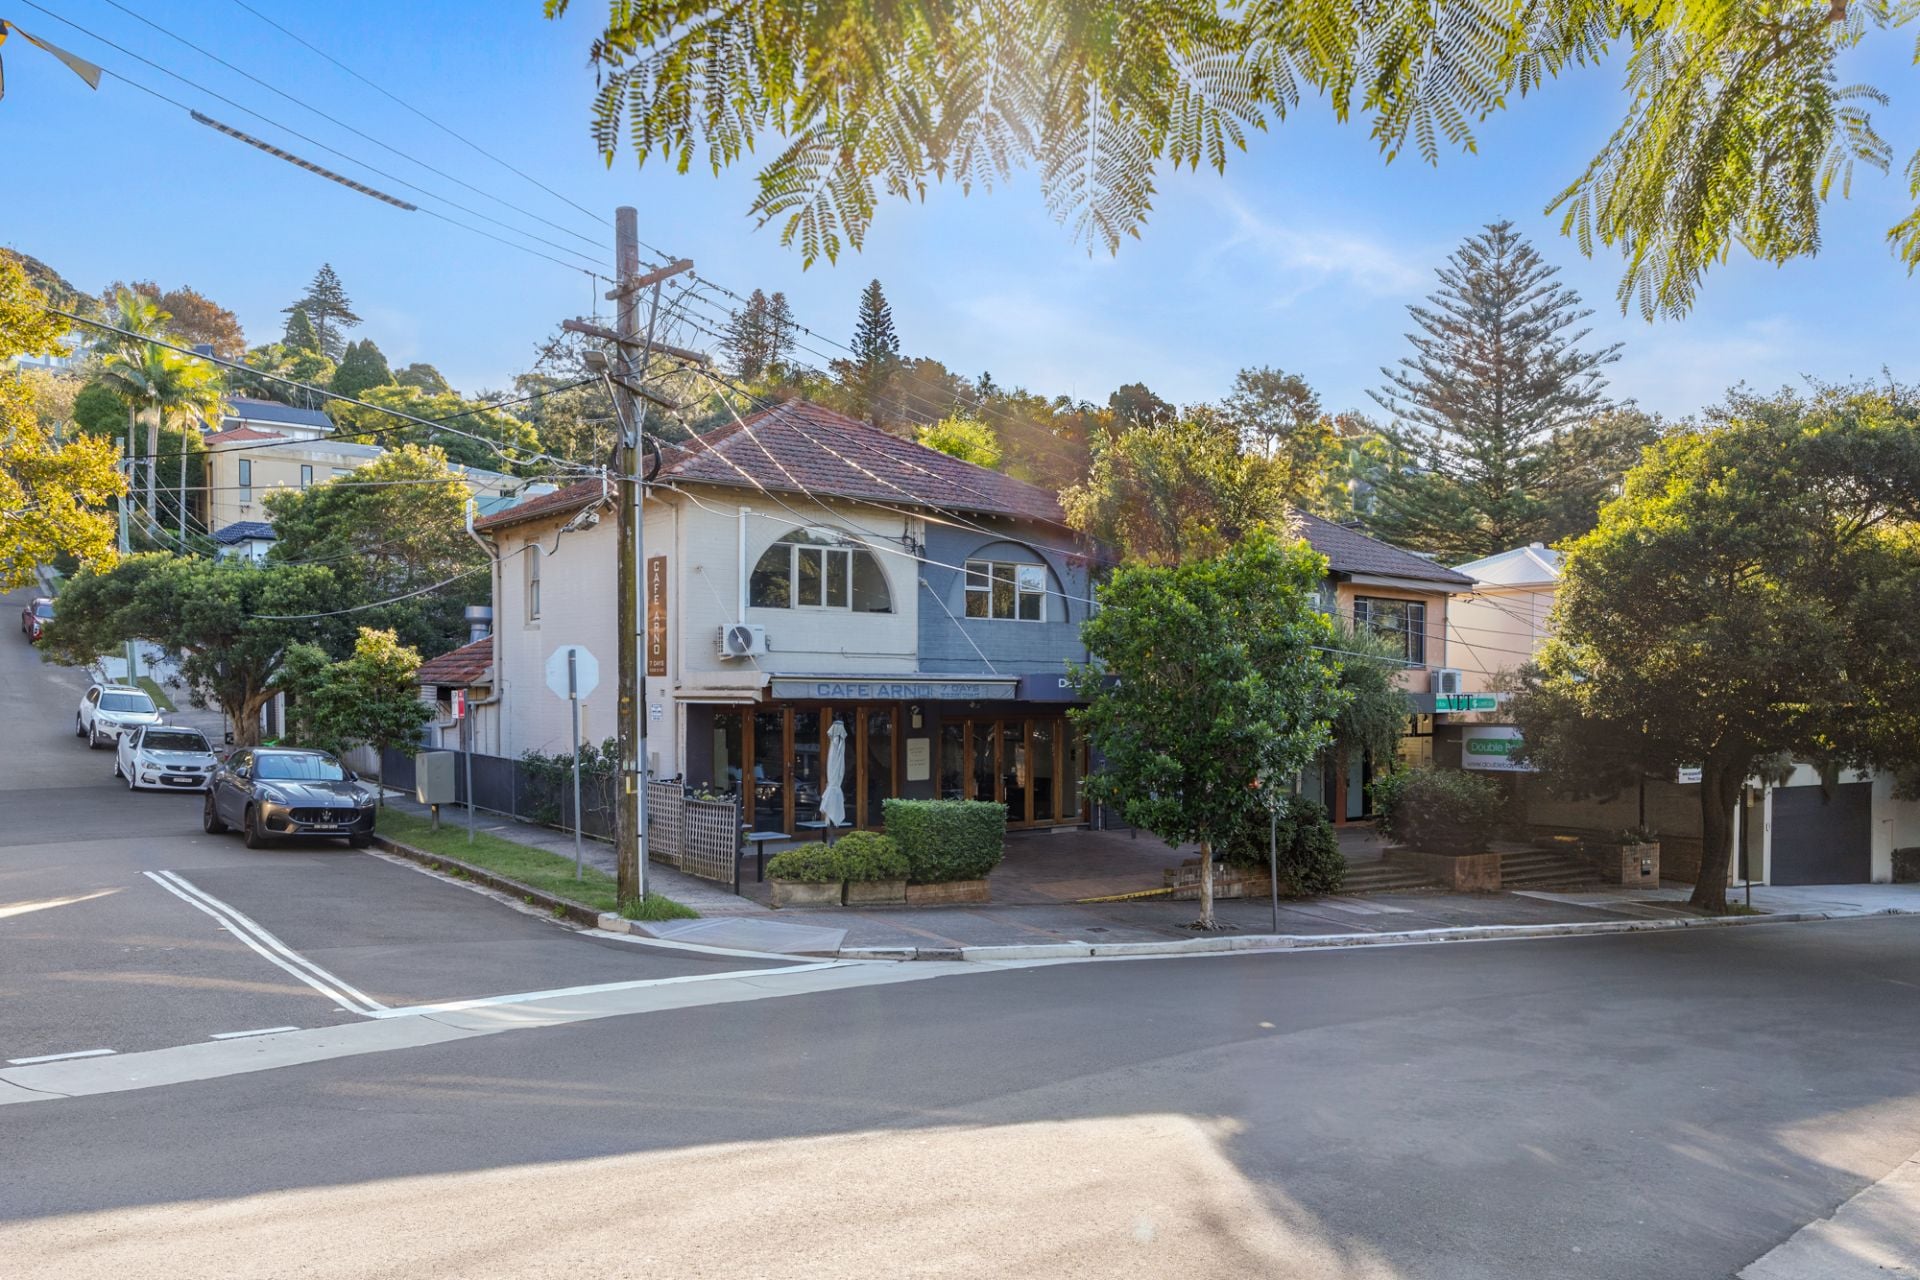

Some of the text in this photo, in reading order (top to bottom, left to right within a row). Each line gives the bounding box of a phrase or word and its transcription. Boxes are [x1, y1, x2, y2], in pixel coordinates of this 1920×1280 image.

[817, 683, 930, 698] CAFE ARNO
[1445, 694, 1473, 711] VET
[1471, 742, 1503, 752] Double
